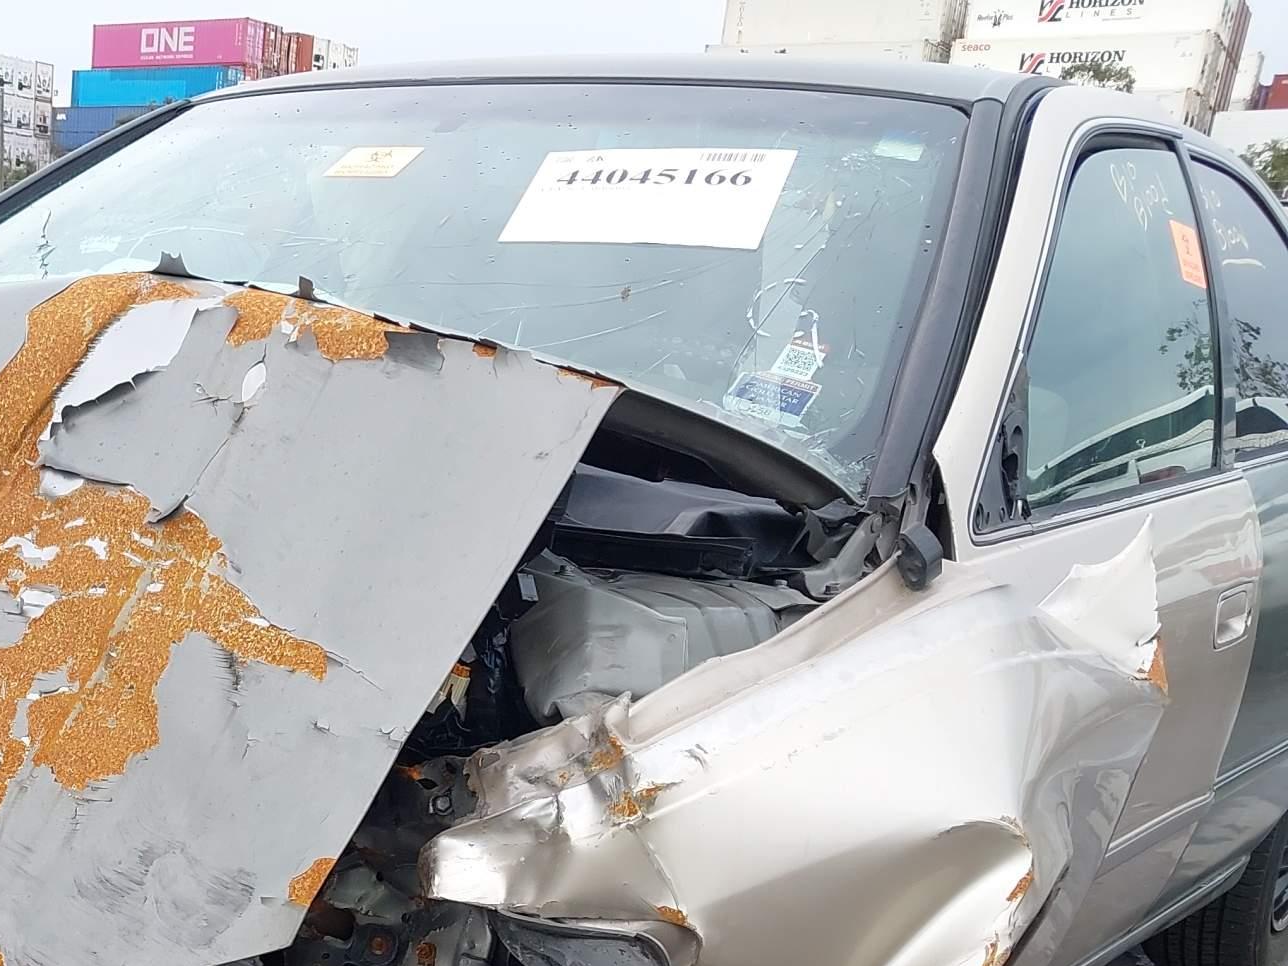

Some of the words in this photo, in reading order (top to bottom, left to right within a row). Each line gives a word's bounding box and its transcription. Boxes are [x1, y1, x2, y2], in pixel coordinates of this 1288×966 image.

[1068, 0, 1145, 9] HORIZON
[1065, 8, 1133, 18] LINES
[140, 26, 196, 54] ONE
[961, 42, 991, 52] seaco
[1047, 50, 1127, 64] HORIZON
[557, 168, 753, 186] 44045166
